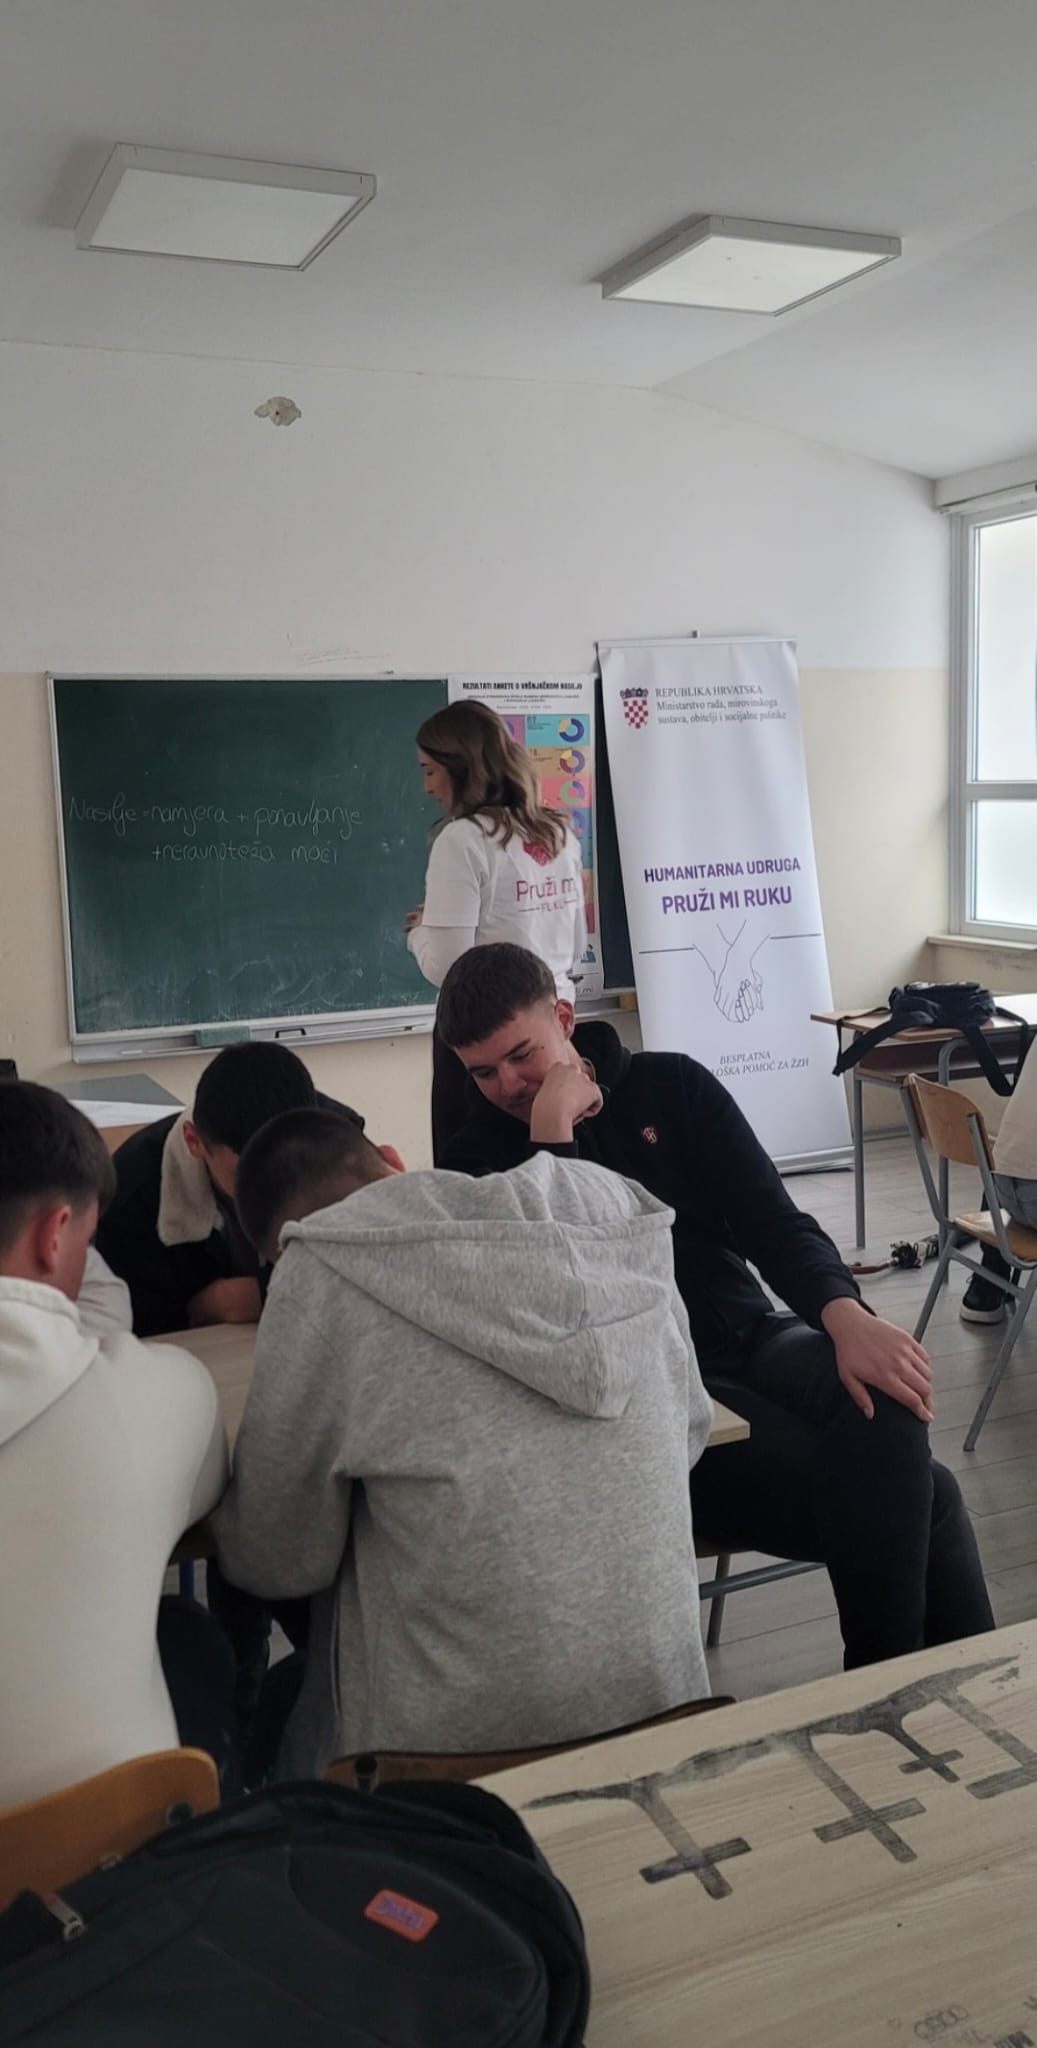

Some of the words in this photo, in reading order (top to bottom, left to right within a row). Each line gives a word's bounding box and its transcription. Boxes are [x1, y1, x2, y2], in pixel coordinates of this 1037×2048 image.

[655, 687, 711, 697] REPUBLIKA
[713, 685, 763, 696] HRVATSKA
[656, 701, 705, 711] Ministarstvo
[706, 699, 726, 709] rada,
[728, 698, 778, 709] mirovinskoga
[658, 715, 689, 724] sustava,
[690, 713, 718, 724] obitelji
[724, 711, 758, 723] socijalne
[67, 792, 137, 838] Nasilje
[644, 862, 744, 883] HUMANITARNA
[747, 857, 801, 875] UDRUGA
[516, 877, 557, 902] Pruži
[561, 877, 575, 895] m
[662, 887, 716, 915] PRUŽI
[719, 890, 740, 909] MI
[743, 885, 792, 908] RUKU
[711, 1065, 741, 1078] LOŠKA
[742, 1061, 776, 1074] POMOĆ
[777, 1060, 790, 1070] ZA
[791, 1057, 809, 1069] ŽZH
[719, 1050, 771, 1065] BESPLATNA
